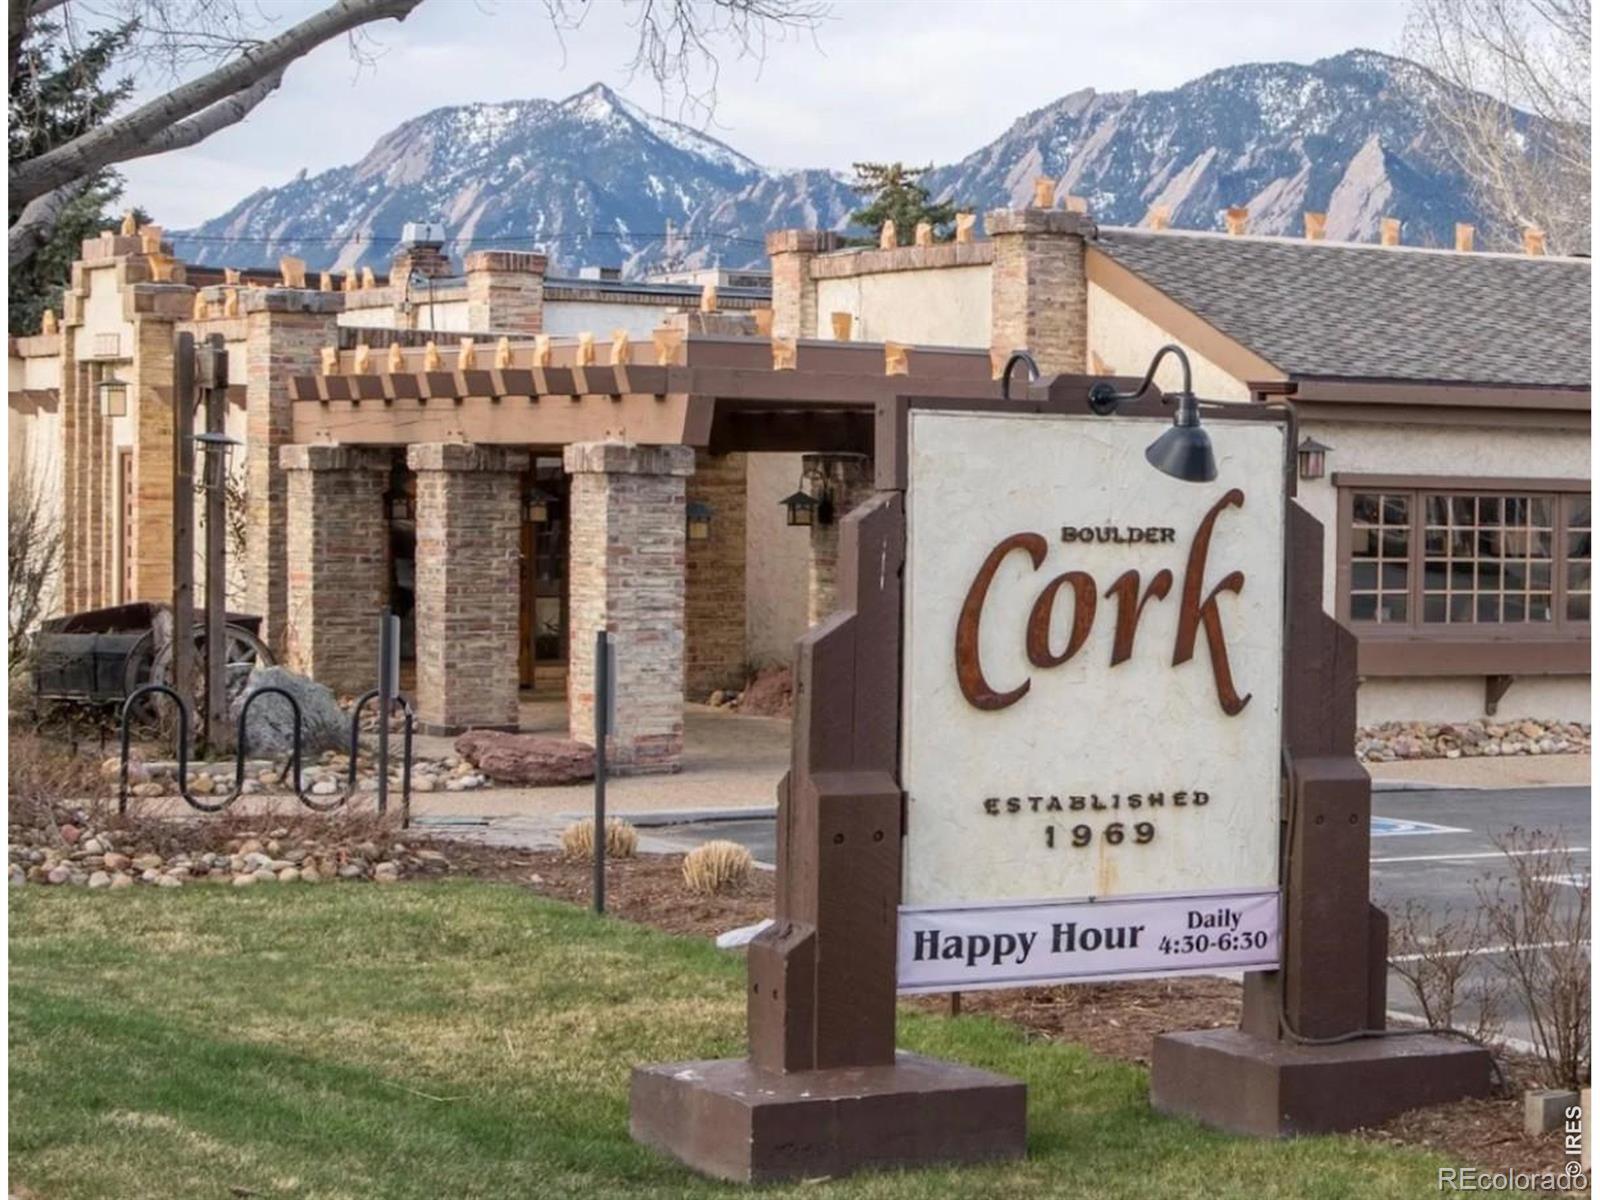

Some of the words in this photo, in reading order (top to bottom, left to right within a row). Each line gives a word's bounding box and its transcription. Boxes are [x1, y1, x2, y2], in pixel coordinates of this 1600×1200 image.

[1061, 526, 1176, 544] BOULDER
[955, 488, 1252, 717] Cork
[983, 791, 1211, 815] ESTABLISHED
[1044, 821, 1156, 849] 1969
[1187, 908, 1243, 932] Daily
[913, 929, 1039, 967] Happy
[1050, 922, 1145, 953] Hour
[1158, 930, 1268, 955] 4:30-6:30
